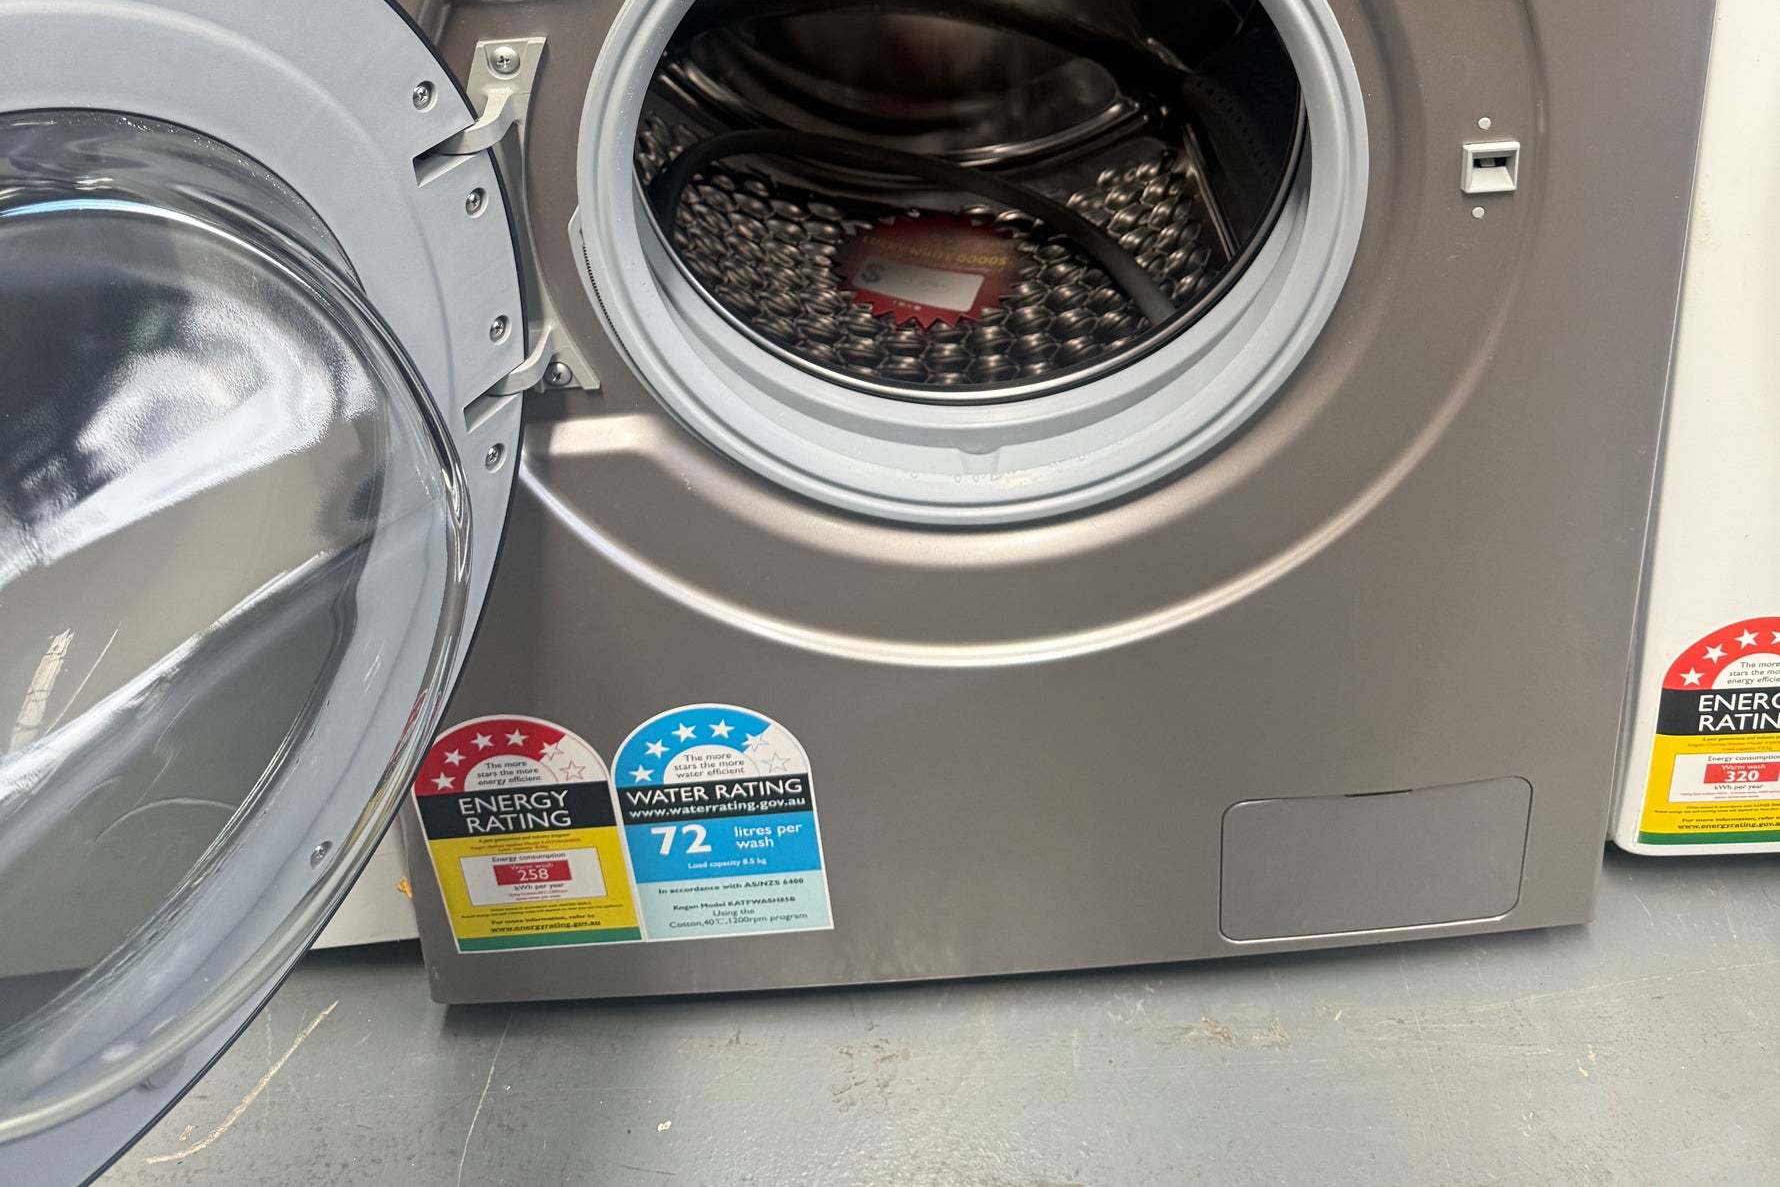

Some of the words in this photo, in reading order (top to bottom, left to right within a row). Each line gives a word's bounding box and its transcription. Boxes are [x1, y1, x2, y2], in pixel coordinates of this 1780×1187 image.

[956, 253, 1008, 266] GOODS
[683, 754, 702, 763] The
[706, 752, 731, 761] more
[485, 762, 502, 770] The
[504, 760, 527, 768] more
[674, 762, 697, 771] stars
[700, 761, 716, 769] the
[719, 759, 745, 767] more
[676, 770, 704, 779] water
[707, 767, 745, 776] efficient
[1724, 770, 1760, 783] 320
[478, 777, 507, 786] energy
[508, 775, 542, 783] efficient
[626, 786, 709, 807] WATER
[715, 778, 803, 800] RATING
[458, 789, 569, 815] ENERGY
[629, 797, 806, 819] www.waterrating.gov.au
[466, 810, 571, 834] RATING
[734, 826, 772, 838] litres
[777, 823, 802, 837] per
[650, 824, 712, 857] 72
[736, 837, 774, 849] wash
[492, 855, 517, 863] Energy
[519, 852, 566, 861] consumption
[688, 861, 707, 869] Load
[709, 859, 741, 868] capacity
[756, 857, 767, 865] kg
[518, 868, 550, 881] 258
[549, 882, 564, 890] year
[670, 883, 720, 894] accordance
[722, 881, 743, 890] with
[673, 903, 699, 912] Kogan
[700, 900, 726, 909] Model
[713, 908, 738, 917] Using
[740, 907, 755, 915] the
[769, 912, 808, 923] program
